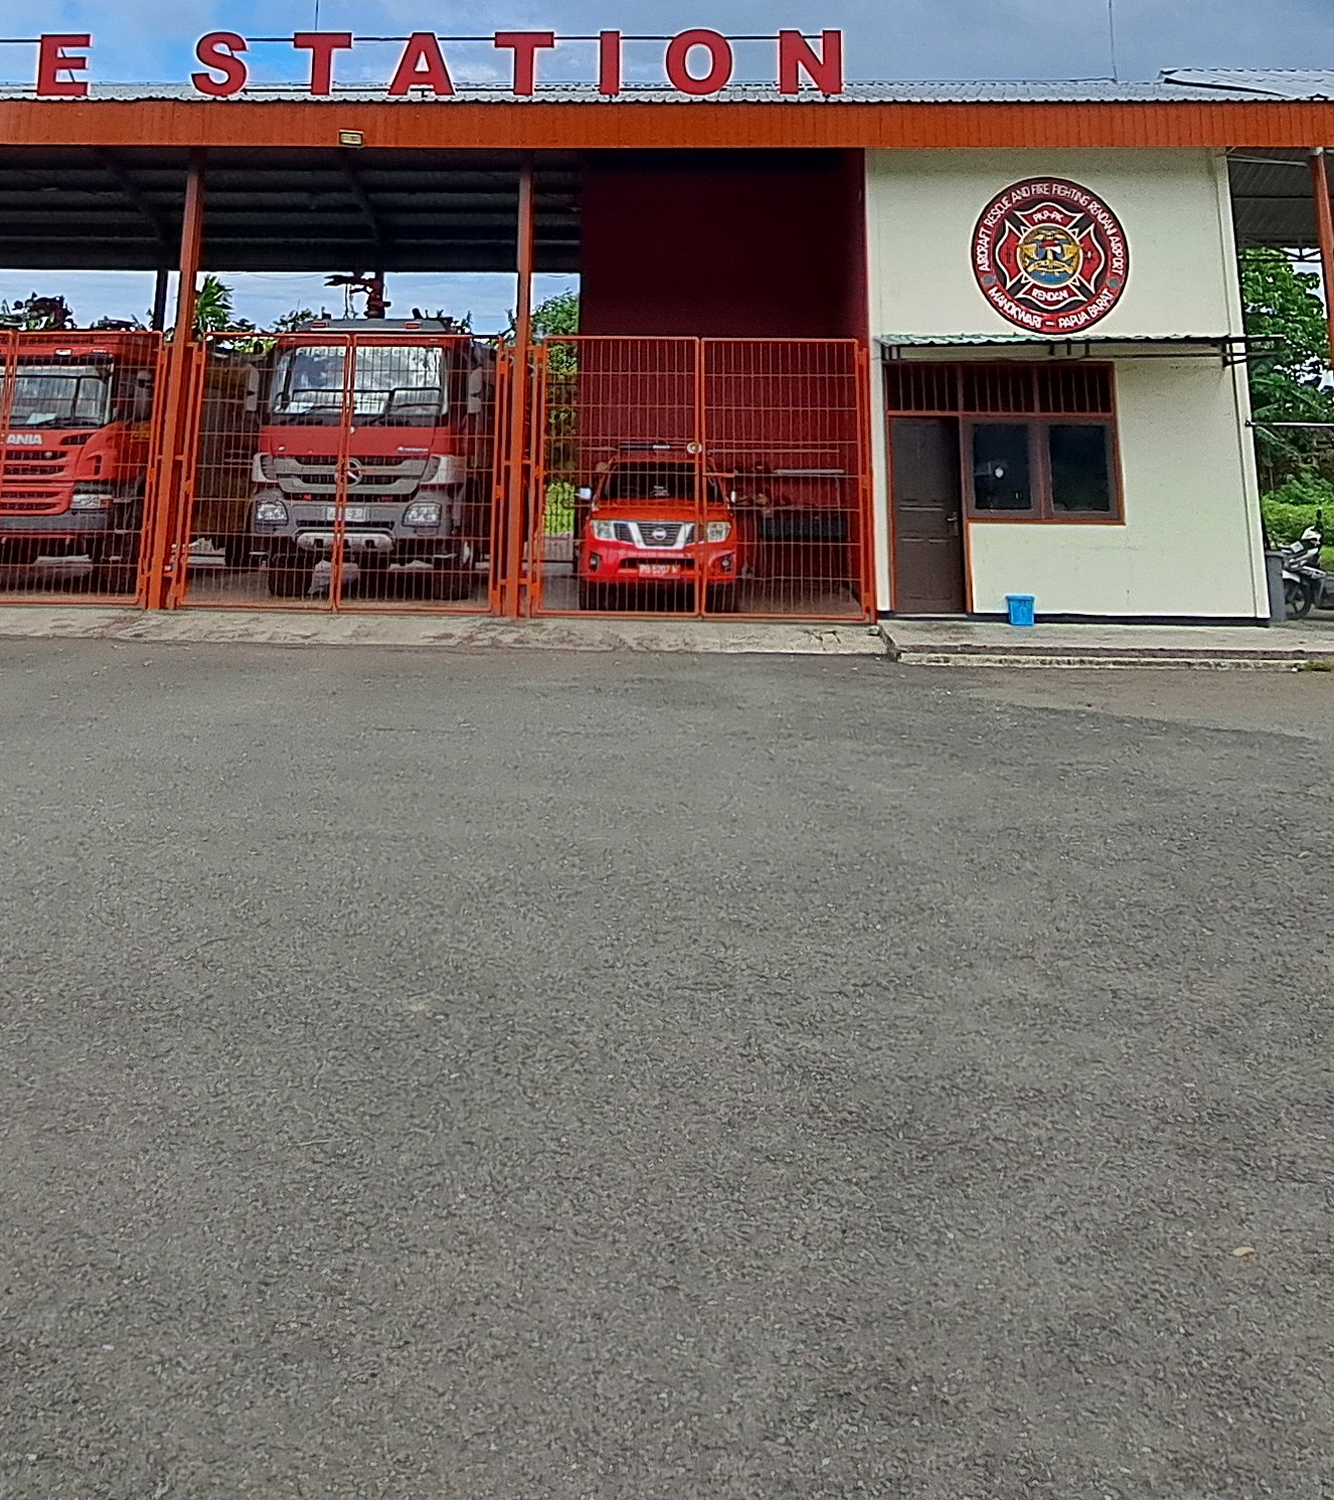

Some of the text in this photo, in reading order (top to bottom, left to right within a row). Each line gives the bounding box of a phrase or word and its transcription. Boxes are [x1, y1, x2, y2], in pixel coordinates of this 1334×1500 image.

[190, 29, 843, 97] STATION
[983, 195, 1012, 228] RESCUE
[1011, 186, 1030, 203] AND
[1031, 183, 1050, 195] FIRE
[1052, 183, 1090, 206] FIGHTING
[1057, 312, 1091, 329] PAPUA
[1088, 288, 1114, 318] BARAT
